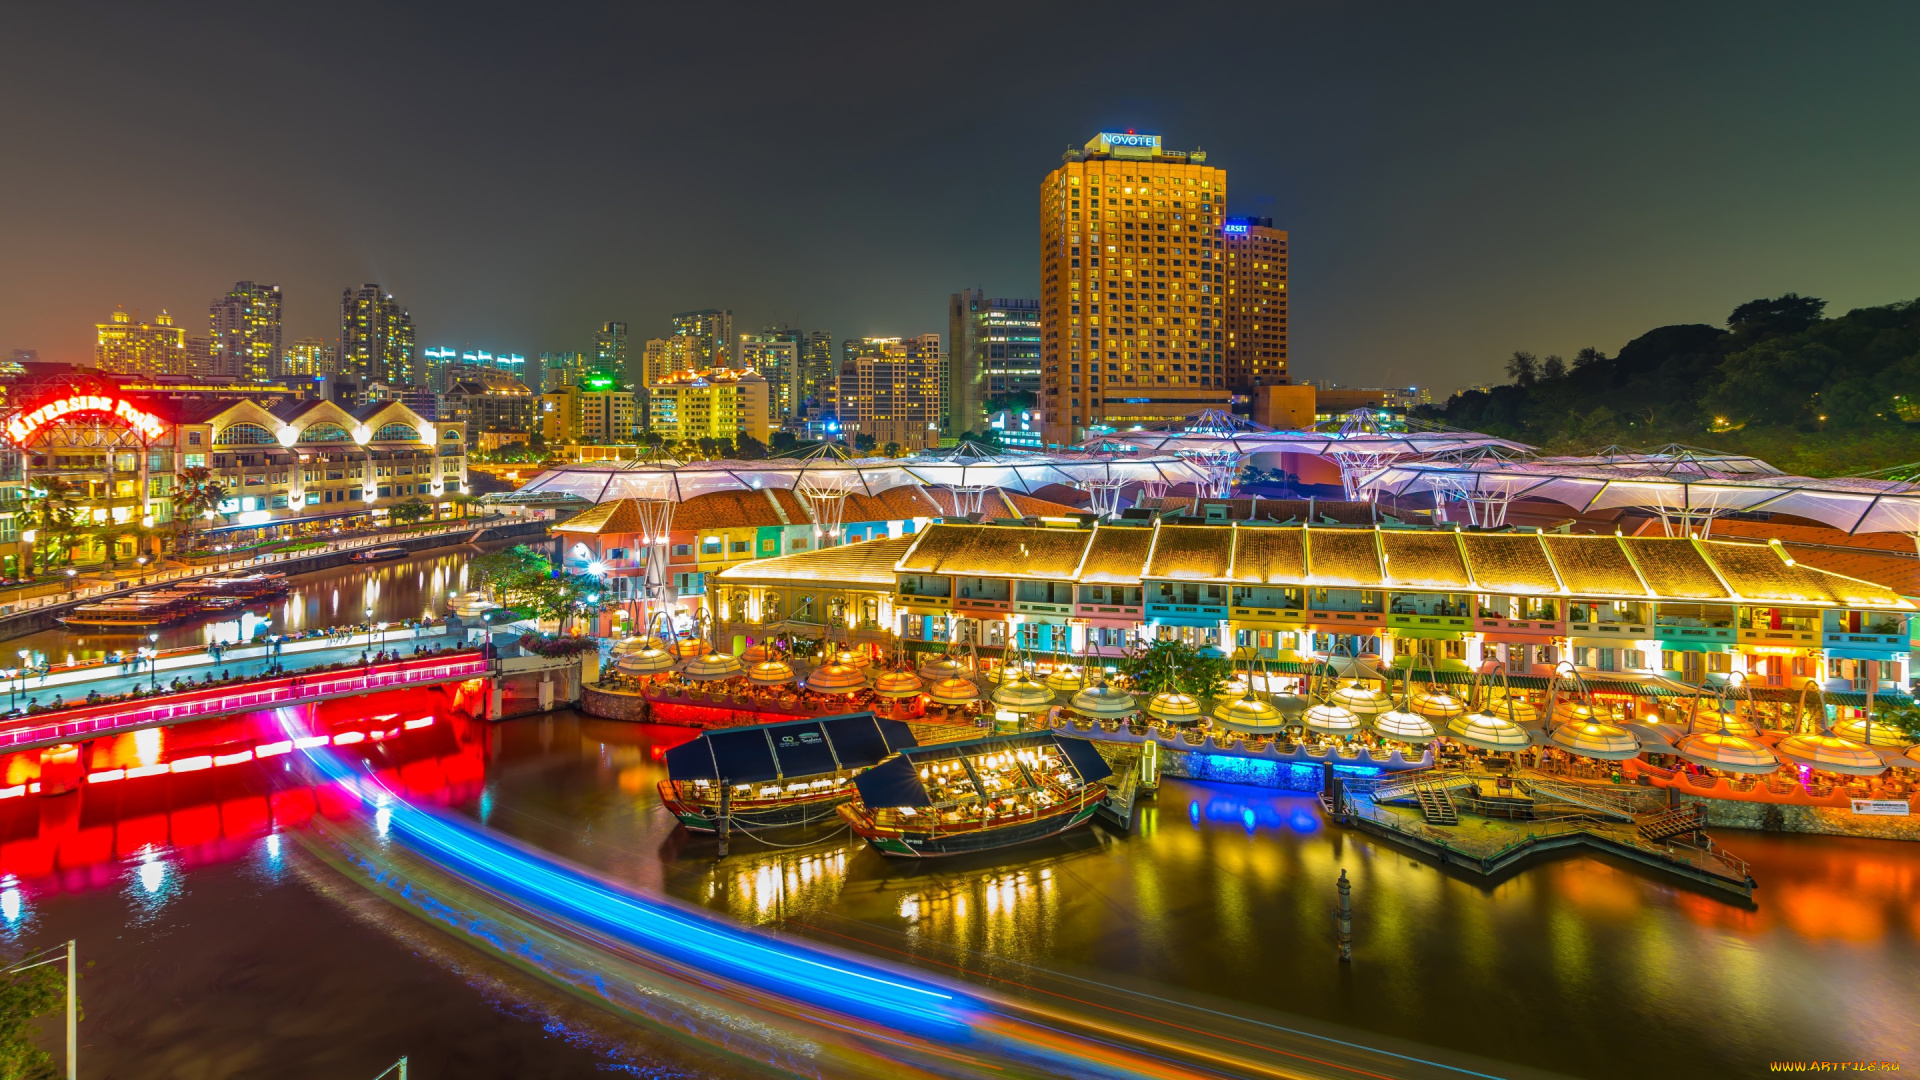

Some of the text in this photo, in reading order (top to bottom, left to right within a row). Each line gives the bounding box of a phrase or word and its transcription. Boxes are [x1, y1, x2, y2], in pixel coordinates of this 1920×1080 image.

[1102, 133, 1160, 147] NOVOTEL
[7, 396, 164, 442] RIVERSIDE POINT
